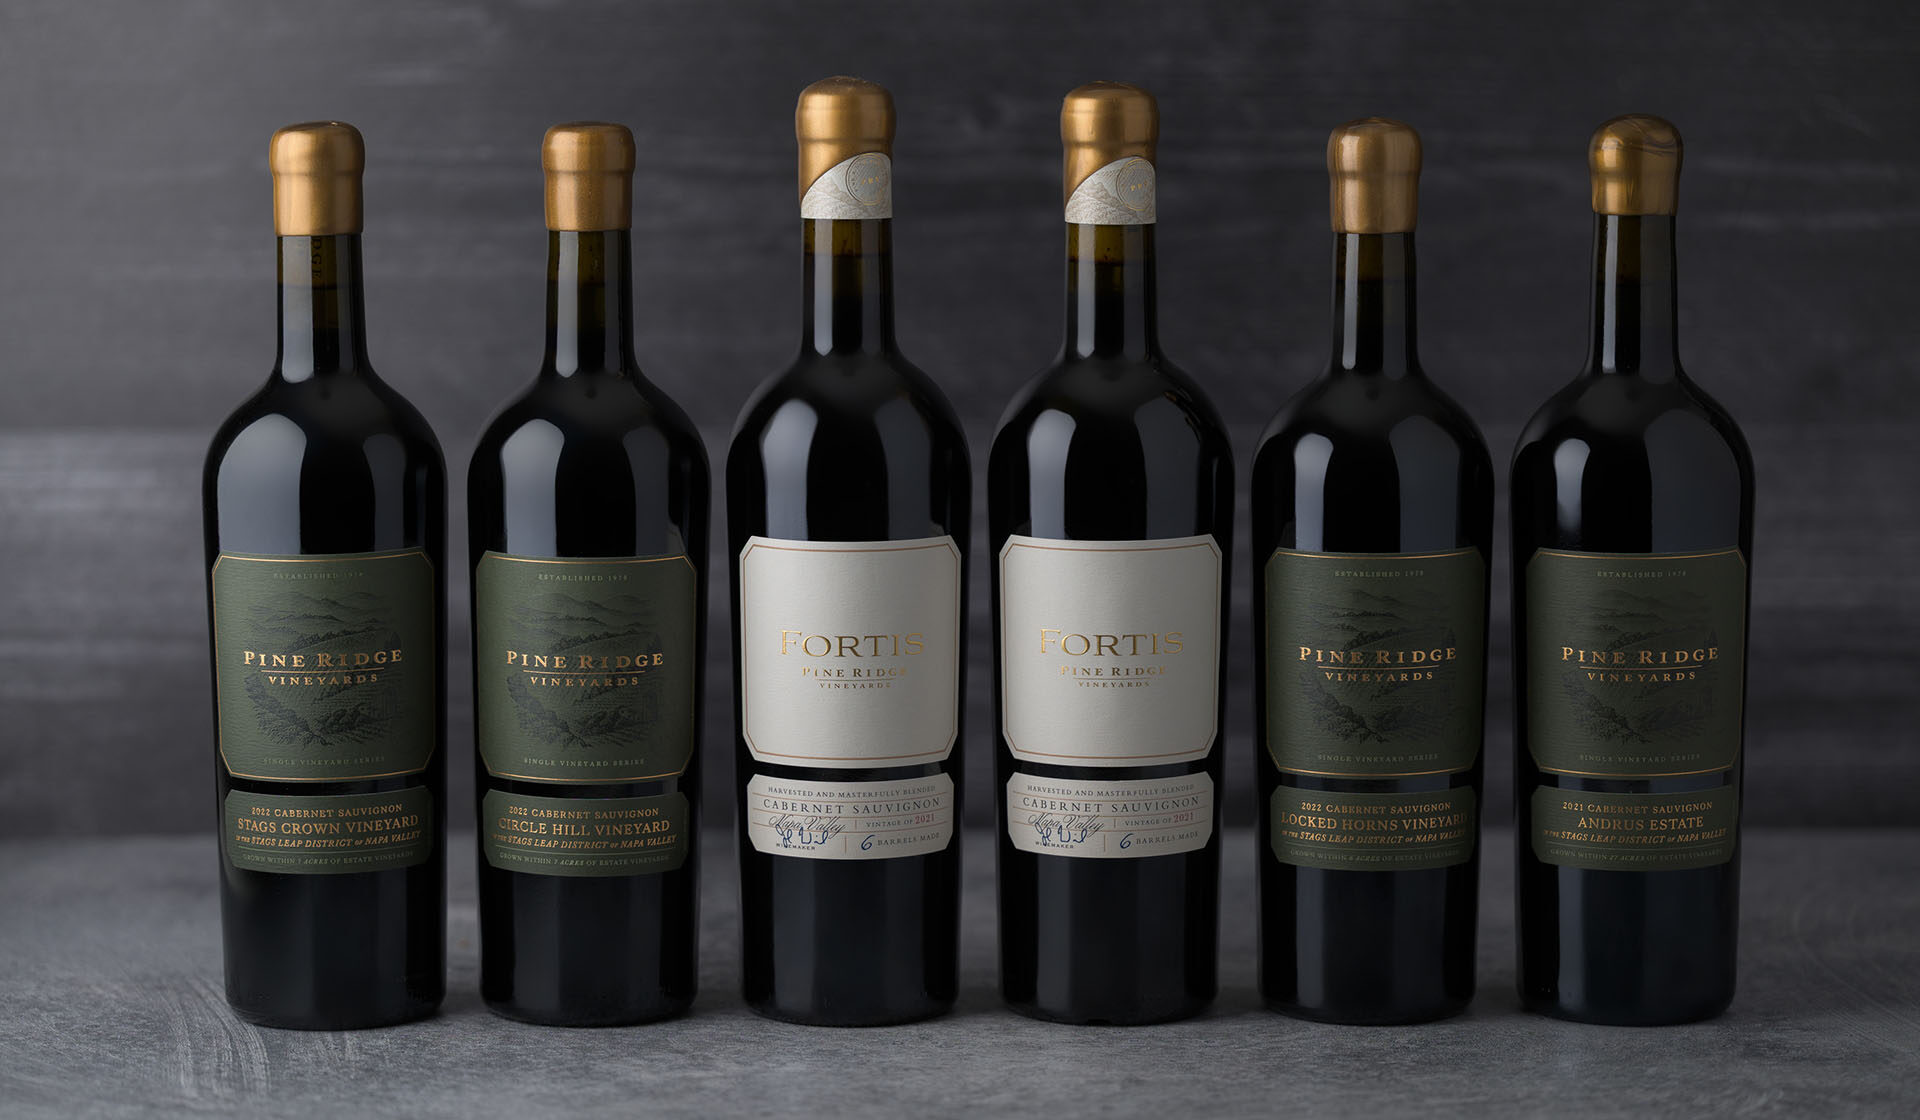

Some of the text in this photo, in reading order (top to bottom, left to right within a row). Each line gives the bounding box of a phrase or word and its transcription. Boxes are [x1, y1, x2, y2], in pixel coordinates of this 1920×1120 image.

[538, 574, 604, 582] ESTABLISHED
[780, 630, 924, 657] FORTIS
[1039, 629, 1185, 657] FORTIS
[243, 649, 402, 668] PINE RIDGE
[506, 650, 665, 669] PINE RIDGE
[1299, 646, 1457, 664] PINE RIDGE
[1561, 646, 1719, 664] PINE RIDGE
[801, 666, 845, 678] PINE
[1060, 665, 1167, 677] PINE RIDGE
[1324, 671, 1433, 682] VINEYARDS
[1586, 671, 1697, 682] VINEYARDS
[268, 673, 378, 686] VINEYARDS
[530, 676, 639, 688] VINEYARDS
[819, 681, 892, 689] VINEYARDS
[524, 757, 555, 766] SINGLE
[612, 758, 645, 767] SERIES
[1318, 754, 1352, 762] SINGLE
[1355, 755, 1404, 763] VINEYARD
[1579, 754, 1612, 762] SINGLE
[1617, 755, 1666, 763] VINEYARD
[768, 786, 813, 797] HARVESTED
[837, 790, 900, 798] MASTERFULLY
[902, 785, 936, 795] BLENDED
[1027, 784, 1072, 795] HARVESTED
[1096, 788, 1159, 797] MASTERFULLY
[1161, 784, 1194, 794] BLENDED
[251, 803, 402, 819] 2022 CABERNET SAUVIGNON
[763, 797, 940, 814] CABERNET SAUVIGNON
[1023, 795, 1200, 813] CABERNET SAUVIGNON
[1301, 801, 1451, 815] 2022 CABERNET SAUVIGNON
[1562, 801, 1712, 815] 2021 CABERNET SAUVIGNON
[508, 805, 659, 820] 2022 CABERNET SAUVIGNON
[1125, 818, 1160, 827] VINTAGE
[1173, 812, 1194, 824] 2021
[237, 814, 419, 835] STAGS CROWN VINEYARD
[497, 817, 671, 836] CIRCLE HILL VINEYARD
[769, 814, 803, 831] Napa
[803, 815, 845, 839] Valley
[866, 820, 900, 828] VINTAGE
[914, 814, 935, 825] 2021
[1028, 812, 1061, 829] Napa
[1062, 814, 1105, 838] Valley
[1280, 811, 1468, 831] LOCKED HORNS VINEYARD
[1577, 816, 1704, 831] ANDRUS ESTATE
[251, 836, 276, 847] STAGS
[278, 839, 304, 848] LEAP
[304, 838, 353, 848] DISTRICT
[364, 836, 389, 846] NAPA
[391, 830, 421, 843] VALLEY
[507, 834, 532, 846] STAGS
[534, 838, 559, 848] LEAP
[560, 840, 609, 849] DISTRICT
[620, 839, 644, 848] NAPA
[647, 834, 677, 846] VALLEY
[860, 832, 940, 851] 6 BARRELS MADE
[1119, 831, 1198, 849] 6 BARRELS MADE
[1299, 831, 1327, 842] STAGS
[1328, 834, 1355, 843] LEAP
[1356, 835, 1404, 844] DISTRICT
[1415, 833, 1438, 843] NAPA
[1560, 831, 1589, 842] STAGS
[1590, 834, 1616, 843] LEAP
[1618, 835, 1666, 844] DISTRICT
[1676, 833, 1699, 842] NAPA
[267, 856, 296, 864] WITHIN
[343, 856, 373, 864] ESTATE
[524, 856, 552, 864] WITHIN
